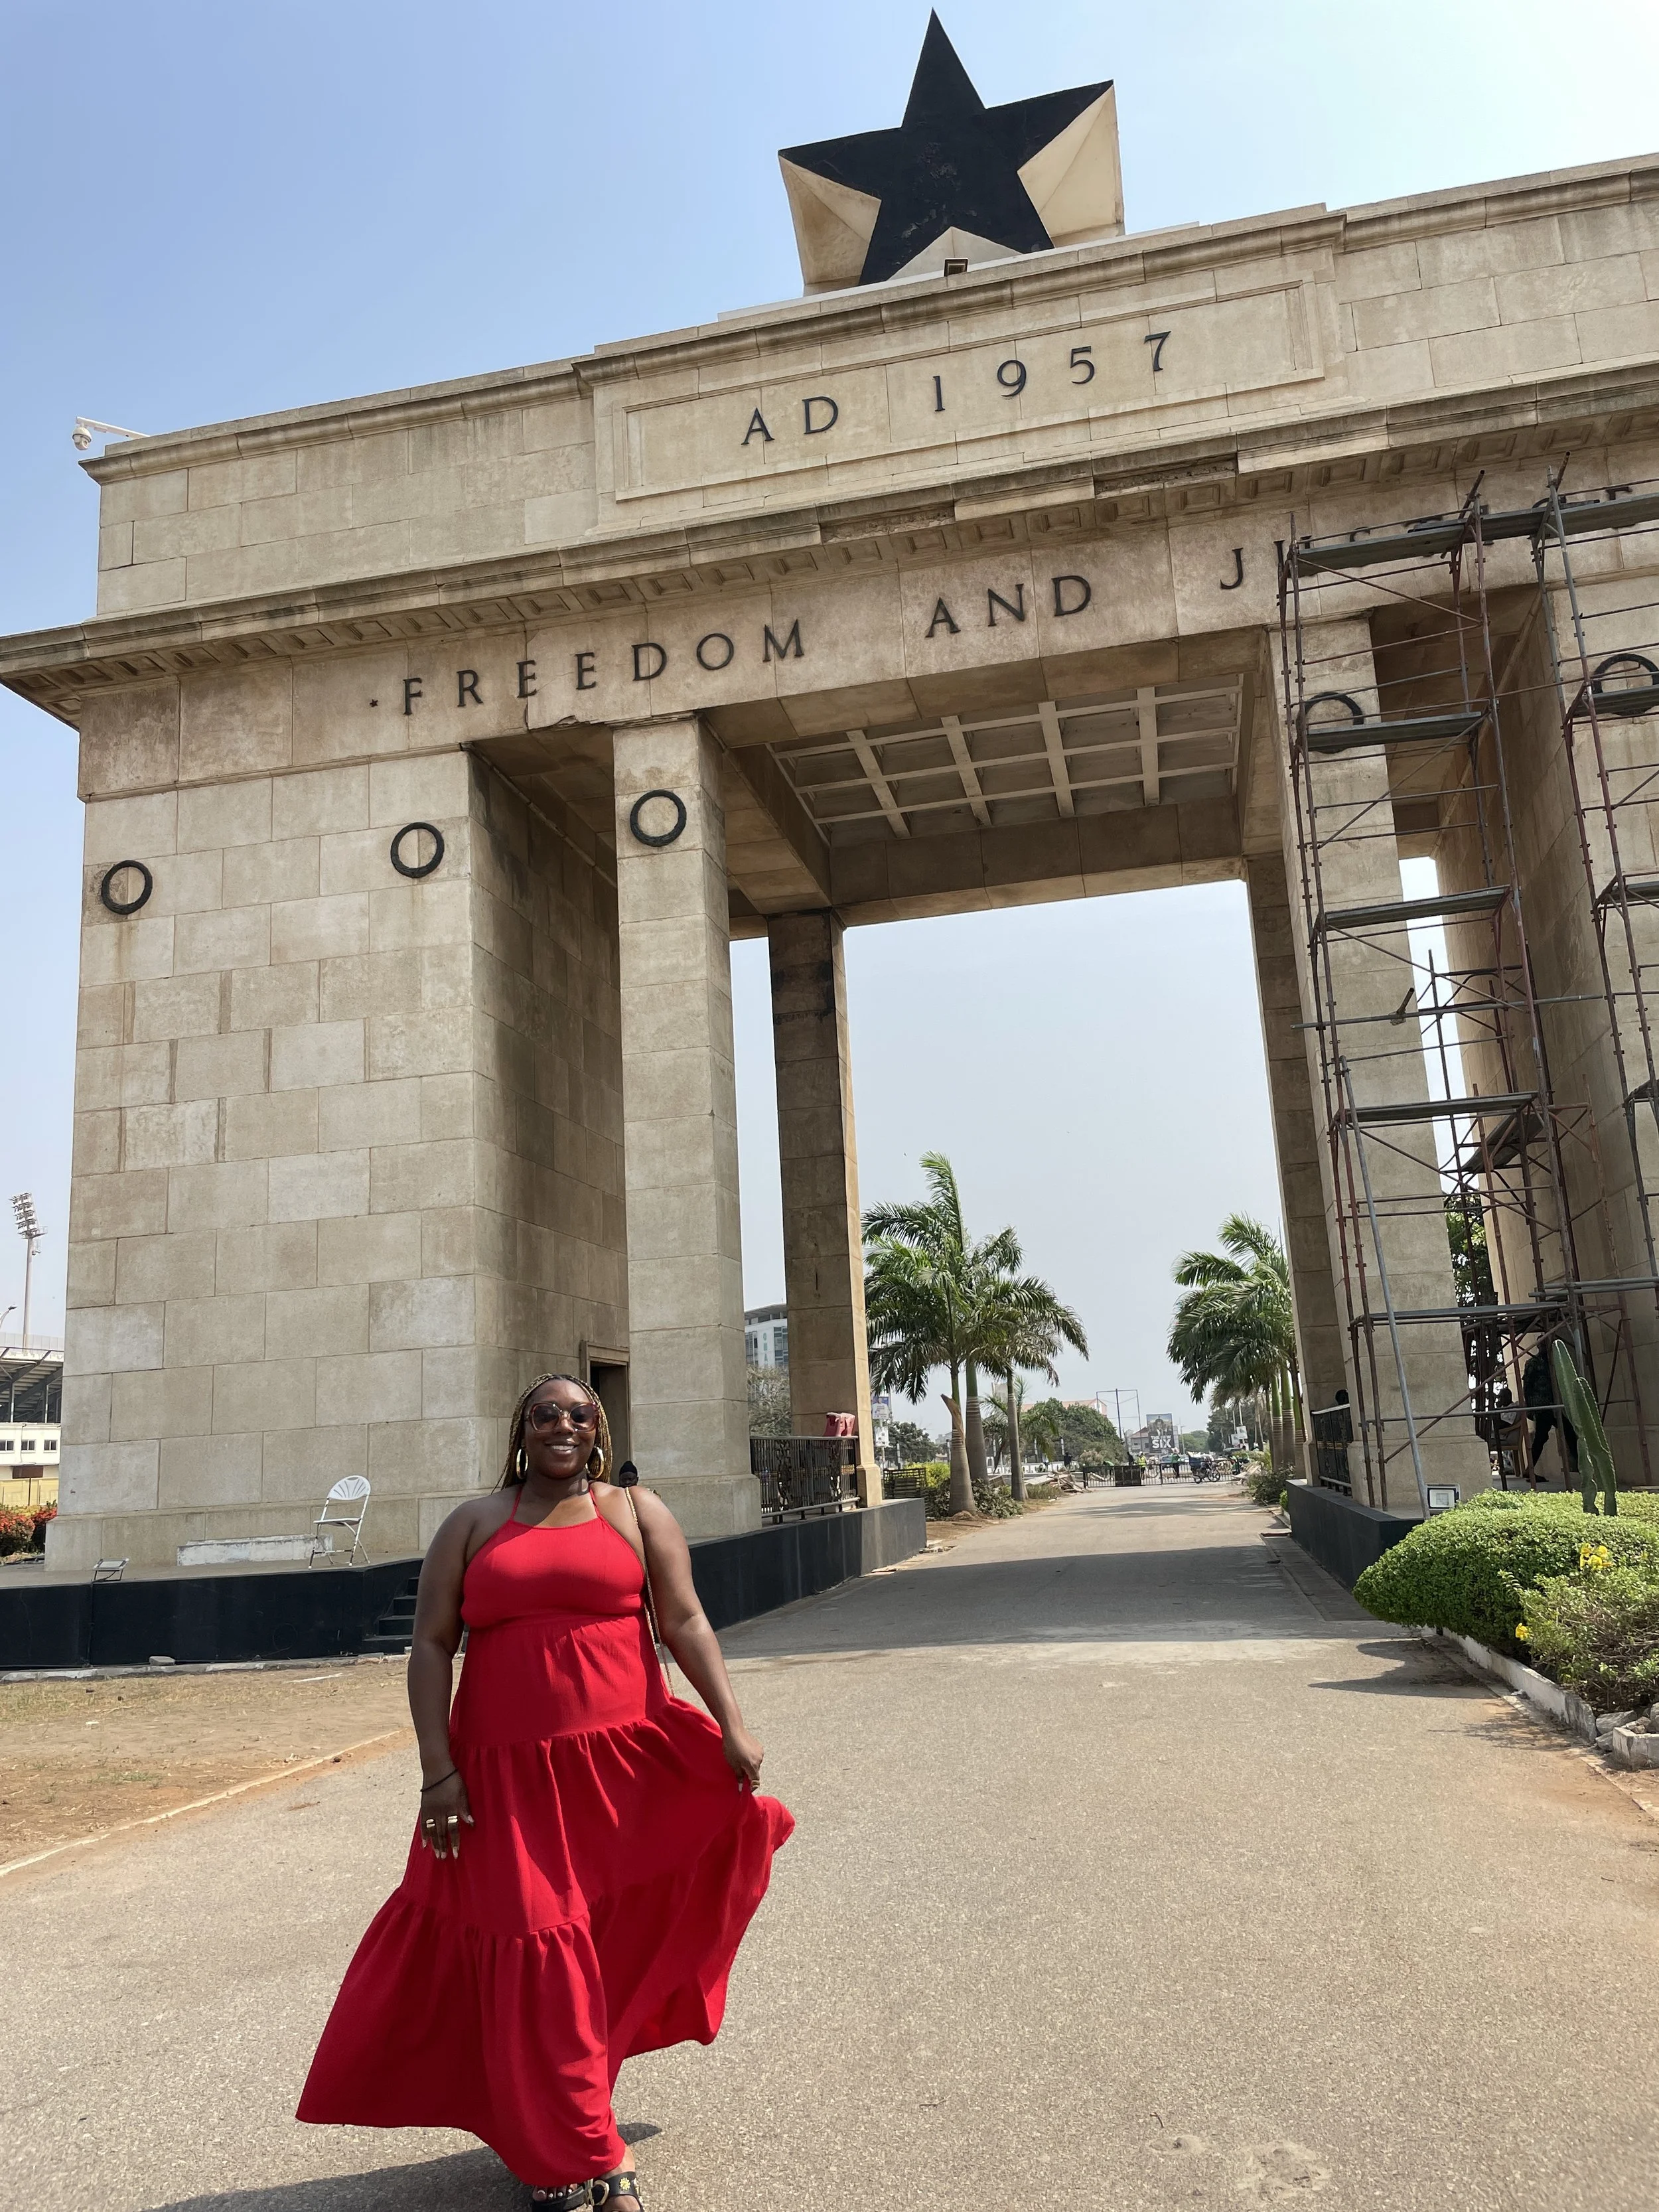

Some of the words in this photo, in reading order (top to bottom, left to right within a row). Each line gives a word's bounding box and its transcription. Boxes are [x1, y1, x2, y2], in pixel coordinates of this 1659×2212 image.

[741, 396, 839, 445] AD
[932, 331, 1171, 411] 1957
[402, 619, 804, 715] FREEDOM
[925, 575, 1092, 638] AND
[1152, 1439, 1172, 1449] SIX
